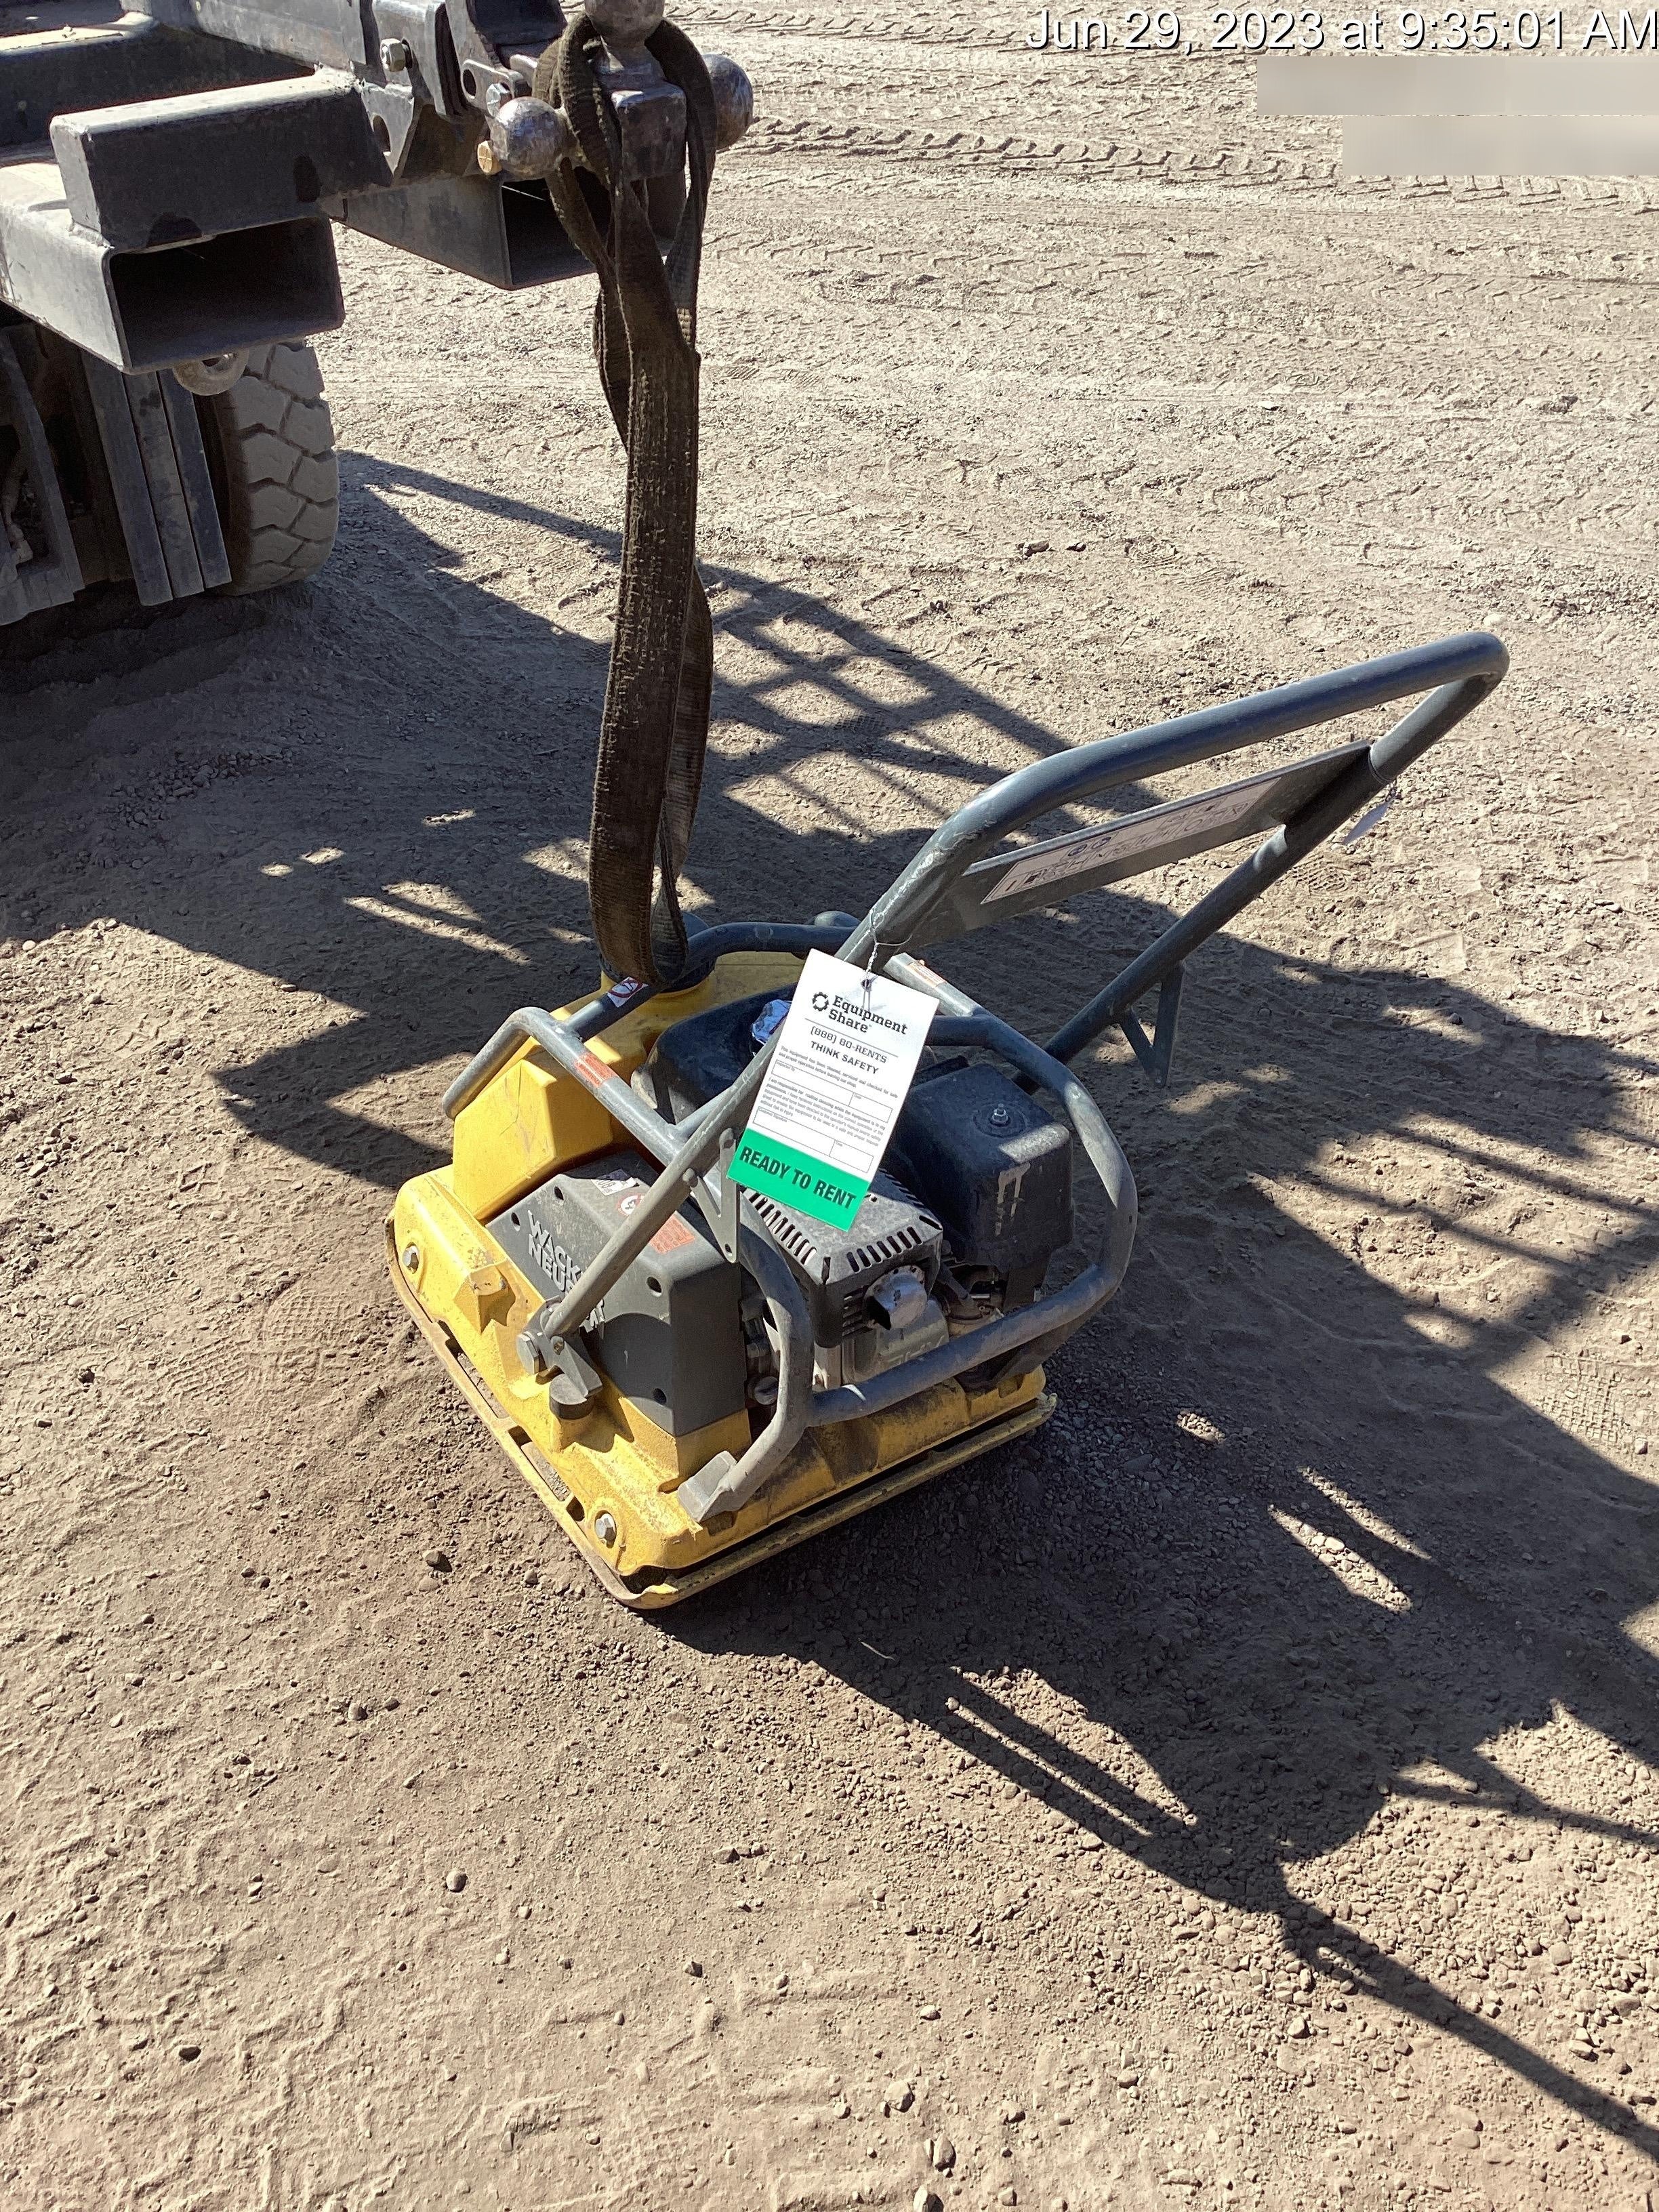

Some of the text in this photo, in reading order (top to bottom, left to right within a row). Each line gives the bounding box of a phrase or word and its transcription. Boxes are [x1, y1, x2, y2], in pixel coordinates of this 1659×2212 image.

[828, 1008, 868, 1033] Share
[832, 995, 907, 1035] Equipment
[810, 1025, 887, 1063] (888) 80-RENTS
[811, 1040, 878, 1074] THINK SAFETY
[739, 1146, 856, 1208] READY TO RENT
